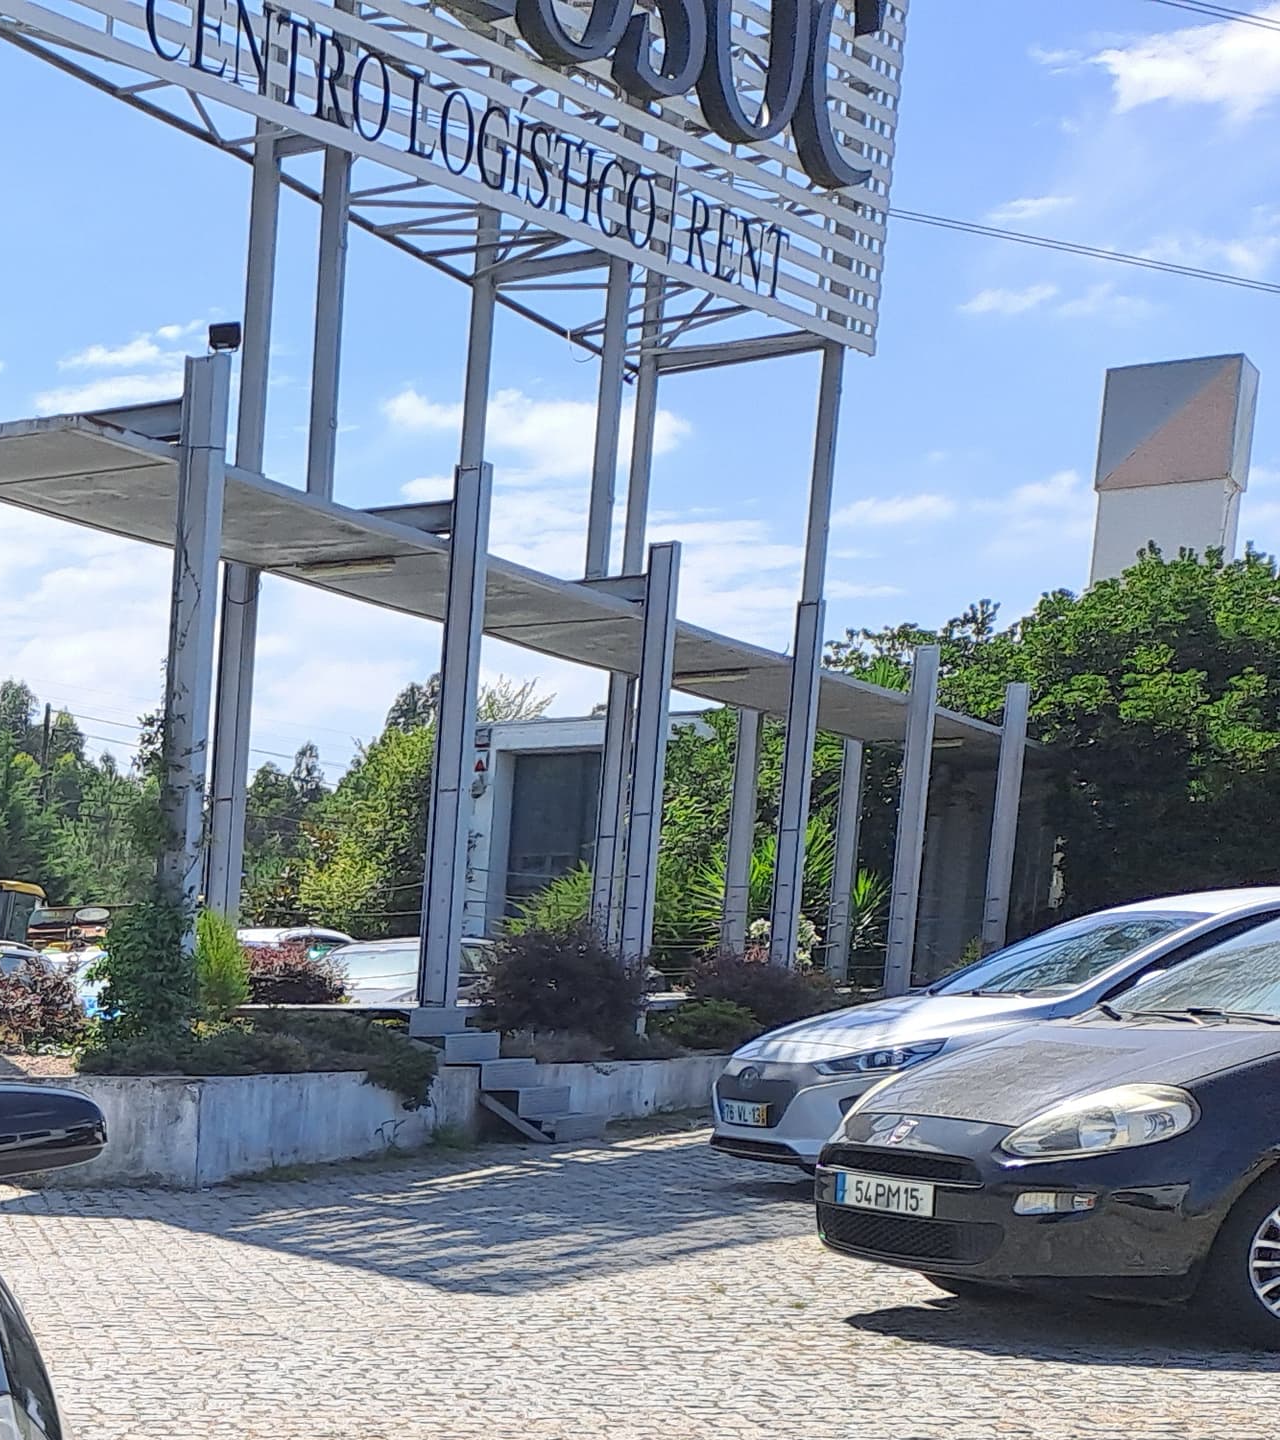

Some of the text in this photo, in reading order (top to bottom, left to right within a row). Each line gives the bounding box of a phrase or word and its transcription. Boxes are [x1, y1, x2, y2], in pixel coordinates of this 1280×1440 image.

[144, 0, 391, 142] CENTRO
[404, 73, 656, 249] LOGÍSTICO
[683, 193, 791, 298] RENT
